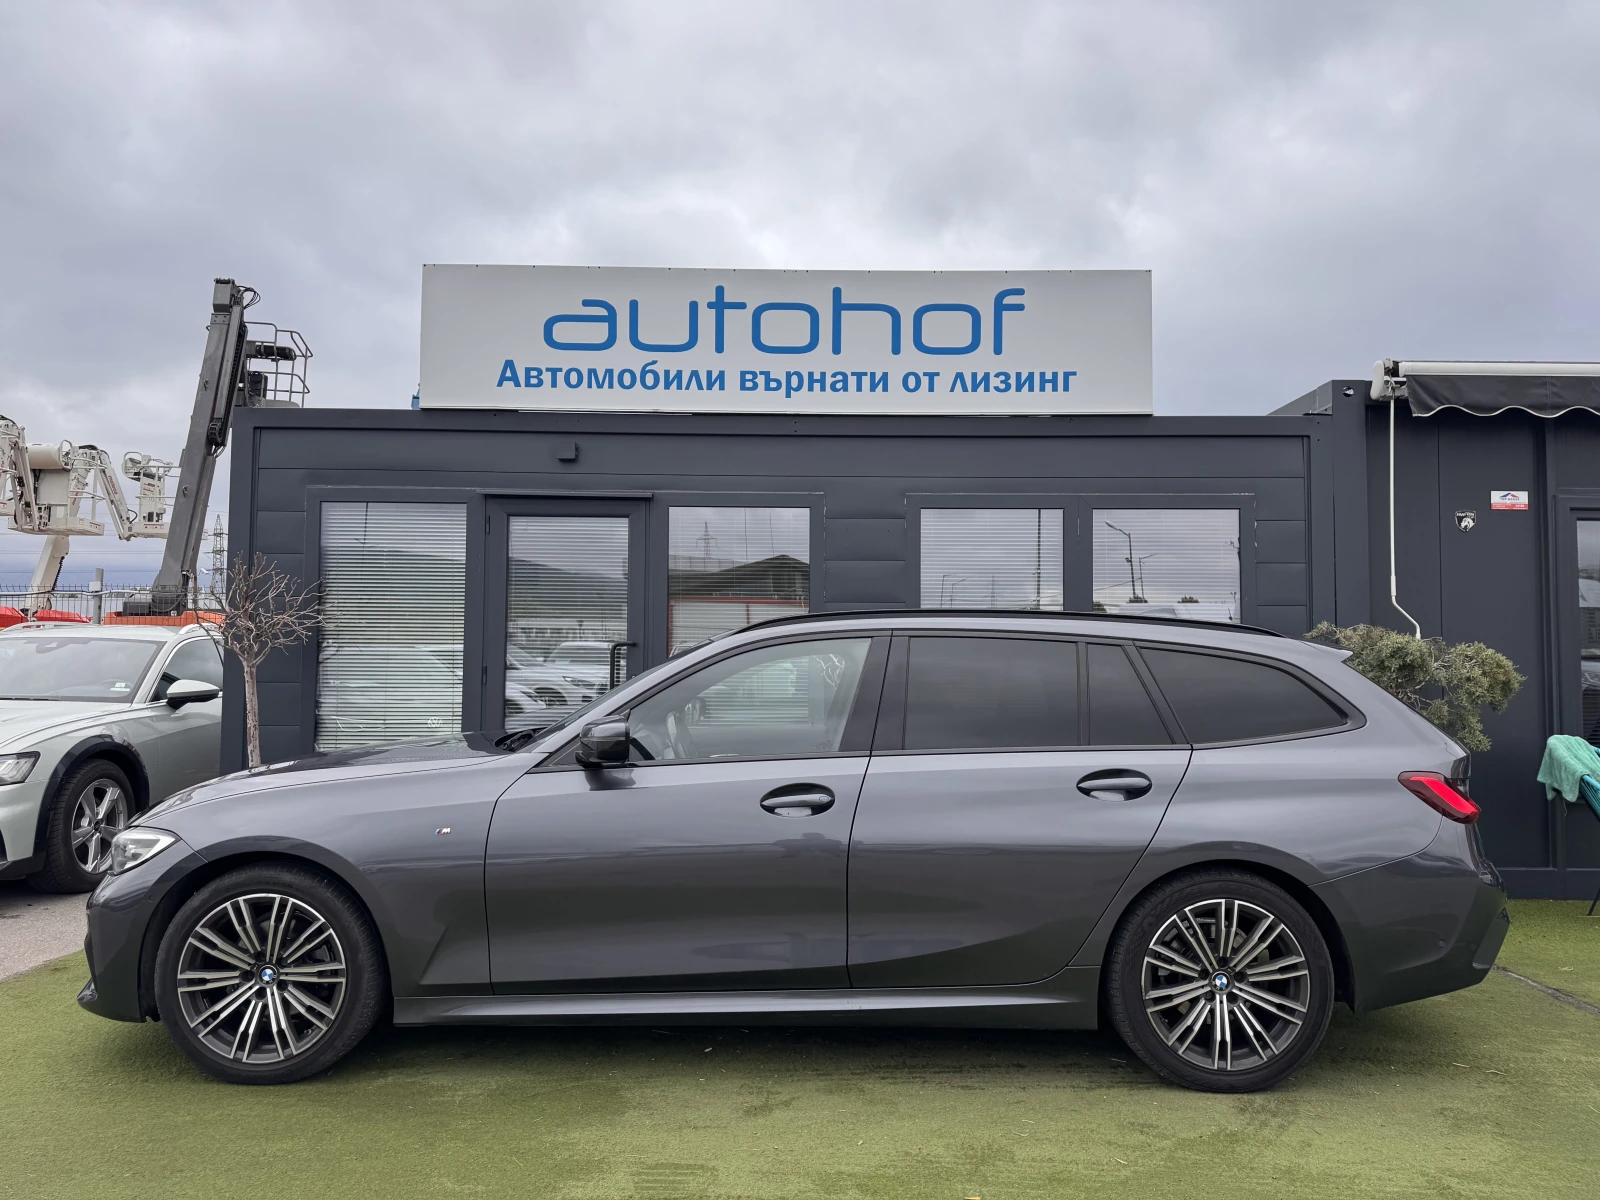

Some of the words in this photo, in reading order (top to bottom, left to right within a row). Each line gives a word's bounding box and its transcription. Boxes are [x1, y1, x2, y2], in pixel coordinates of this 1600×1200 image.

[543, 285, 1026, 357] autohof
[497, 359, 726, 391] Автомобили
[739, 369, 889, 399] върнати
[901, 371, 941, 393] от
[949, 371, 1077, 394] лизинг
